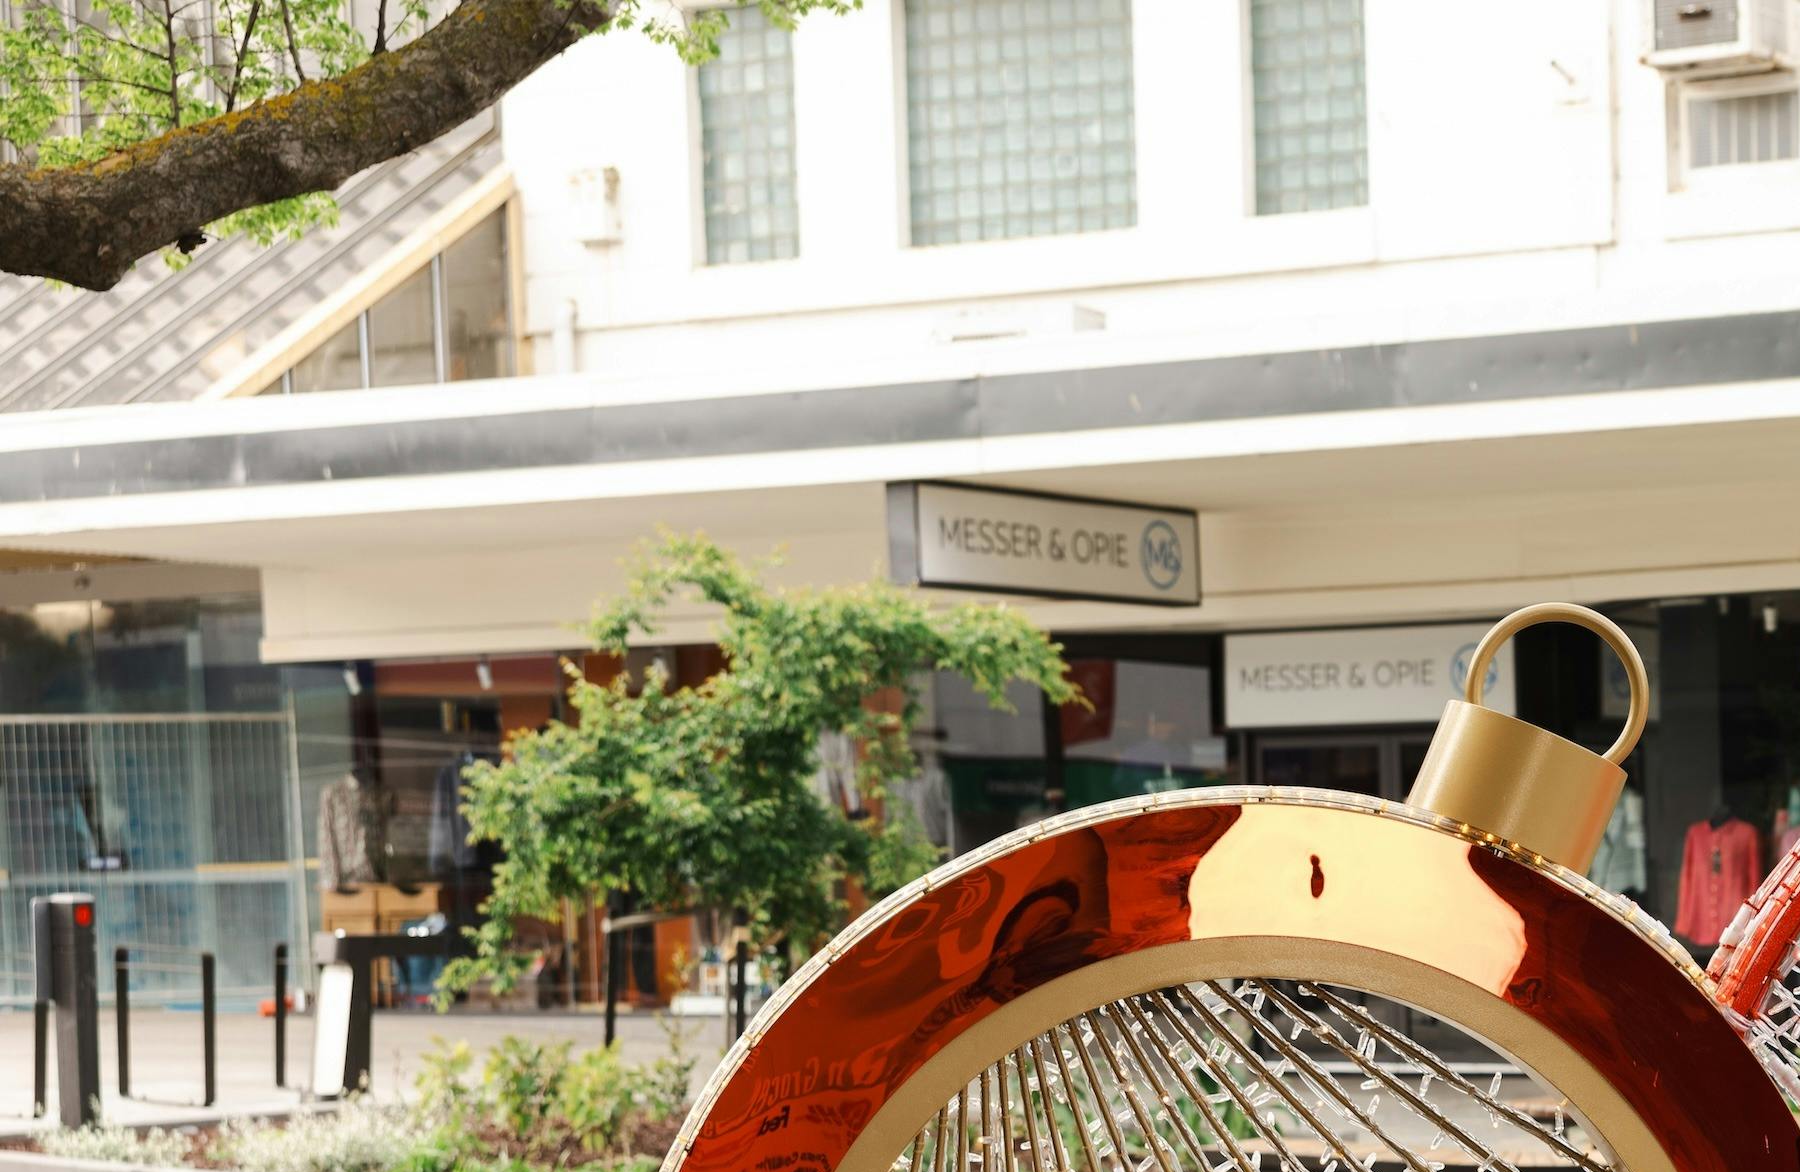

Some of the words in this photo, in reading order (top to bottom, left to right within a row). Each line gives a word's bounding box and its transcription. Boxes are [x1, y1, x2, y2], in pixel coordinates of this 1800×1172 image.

[939, 516, 1042, 560] MESSER
[1048, 527, 1067, 563] &
[1071, 528, 1130, 569] OPIE
[1239, 662, 1341, 691] MESSER
[1349, 661, 1366, 689] &
[1372, 658, 1436, 689] OPIE
